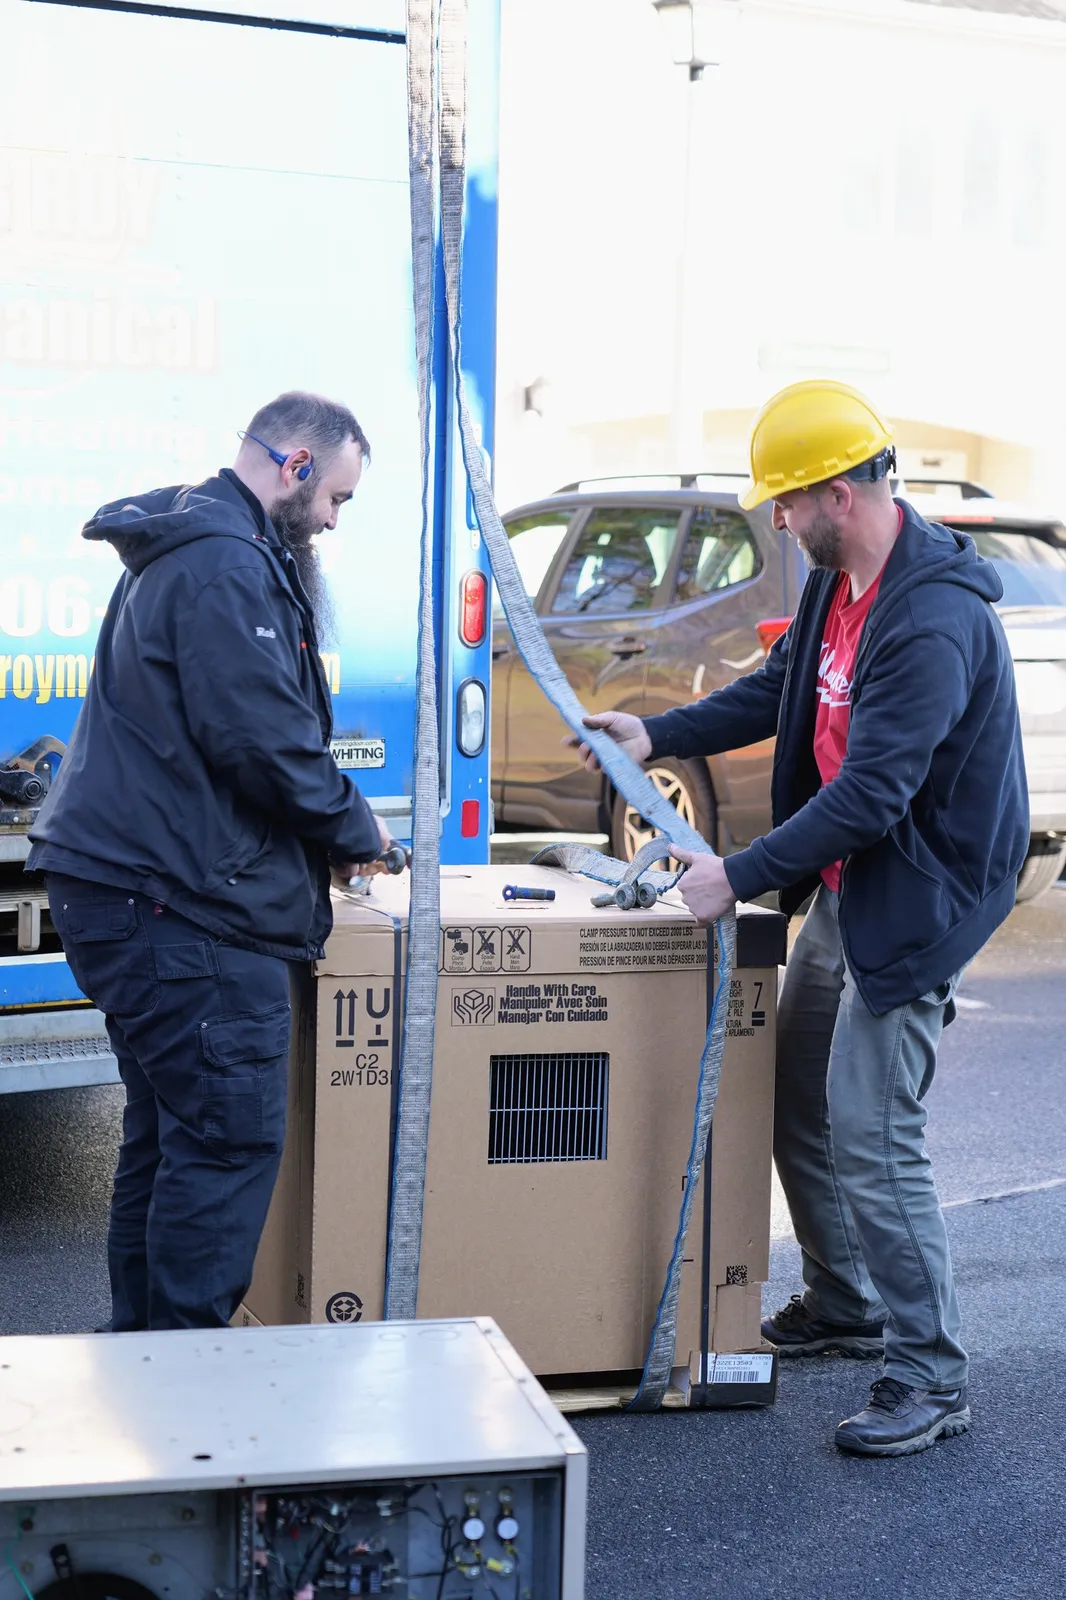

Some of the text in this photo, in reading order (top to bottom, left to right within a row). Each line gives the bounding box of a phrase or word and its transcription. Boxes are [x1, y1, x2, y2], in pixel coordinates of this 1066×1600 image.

[0, 653, 96, 705] roym
[331, 747, 384, 760] WHITING
[579, 926, 694, 938] CLAMP PRESSURE TO NOT EXCEED 2000 LBS
[579, 941, 600, 952] PRESIÓN
[600, 942, 607, 952] DE
[608, 942, 614, 952] LA
[614, 942, 645, 951] ABRAZADERA
[645, 942, 652, 951] NO
[671, 940, 693, 950] SUPERAR
[693, 940, 701, 950] LAS
[579, 956, 607, 966] PRESSION
[607, 956, 615, 966] DE
[616, 956, 631, 965] PINCE
[632, 955, 648, 965] POUR
[648, 955, 656, 965] NE
[657, 954, 667, 965] PAS
[668, 953, 695, 965] DÉPASSER
[506, 983, 597, 998] Handle With Care
[730, 980, 742, 989] TACK
[729, 989, 743, 998] EIGHT
[753, 981, 763, 1010] 7
[499, 995, 608, 1011] Manipuler Avec Soin
[497, 1009, 608, 1025] Manejar Con Cuidado
[733, 1008, 743, 1017] PILE
[355, 1053, 379, 1070] C2
[330, 1069, 393, 1086] 2W1D3
